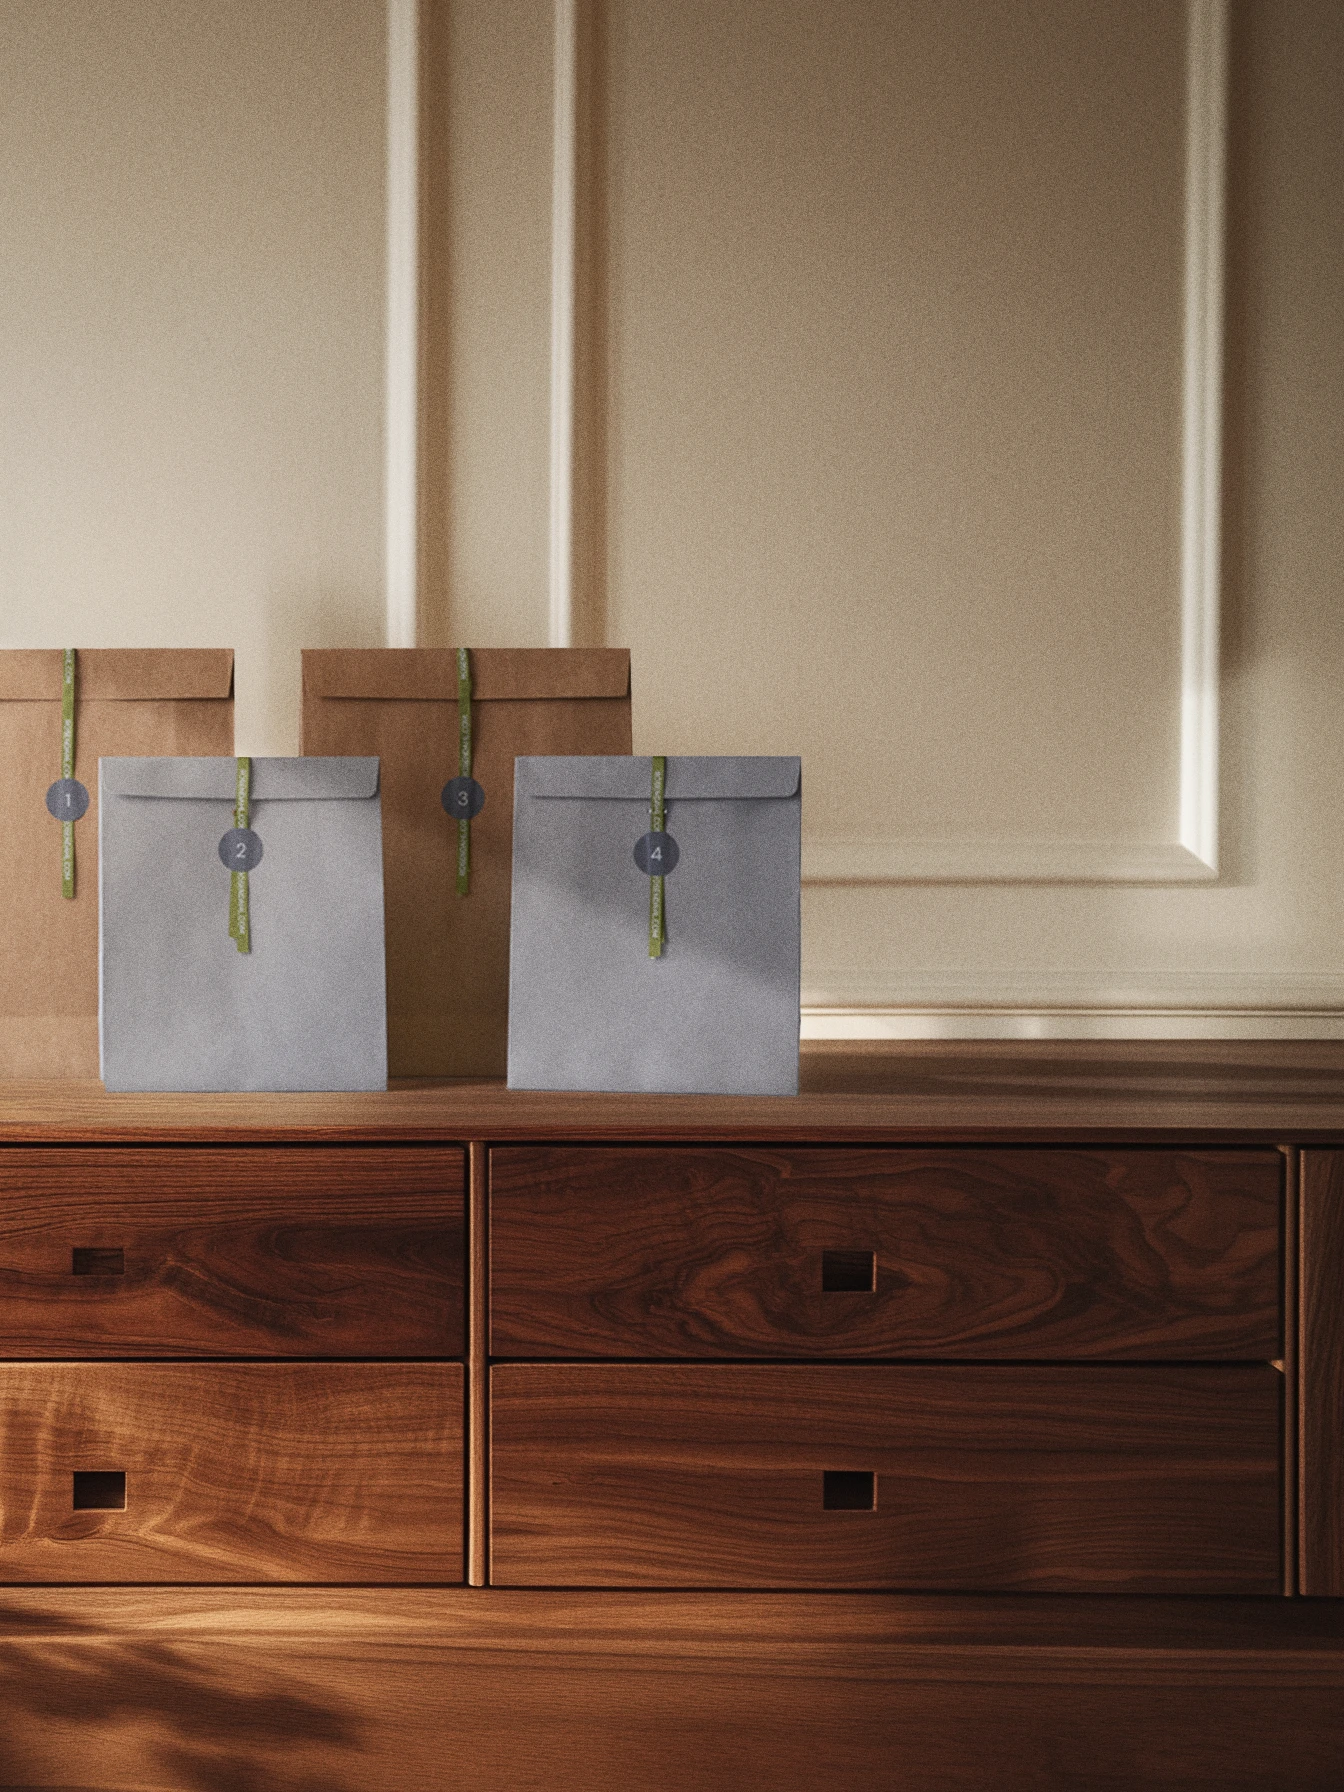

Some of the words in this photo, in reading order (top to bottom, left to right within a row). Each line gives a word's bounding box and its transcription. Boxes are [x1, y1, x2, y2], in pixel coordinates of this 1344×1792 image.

[65, 793, 71, 808] 1
[457, 790, 469, 807] 3
[236, 842, 247, 859] 2
[650, 845, 663, 862] 4
